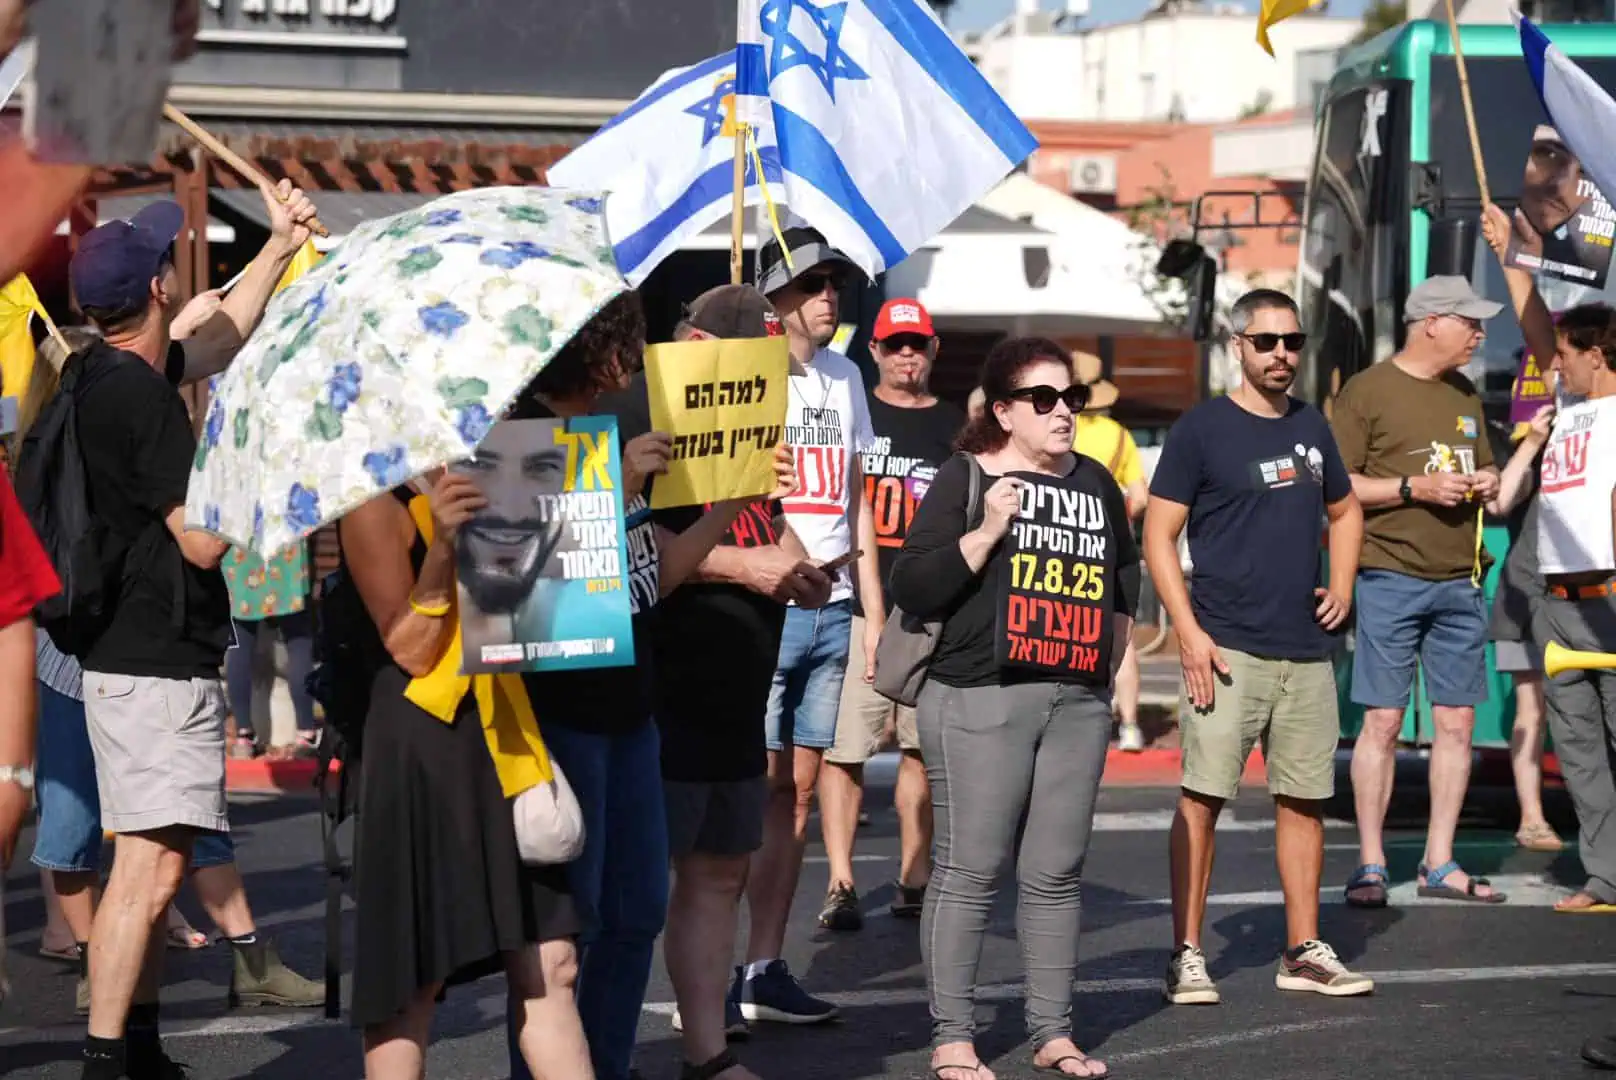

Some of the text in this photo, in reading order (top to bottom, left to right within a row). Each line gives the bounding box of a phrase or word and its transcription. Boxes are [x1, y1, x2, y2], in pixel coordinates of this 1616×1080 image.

[685, 374, 768, 409] למה הם
[673, 424, 781, 460] עדיין בעזה
[817, 427, 844, 446] אותם
[553, 426, 615, 492] אל
[537, 491, 616, 522] תשאירו
[1019, 481, 1105, 531] עוצרים
[571, 519, 618, 549] אותי
[1012, 522, 1106, 560] את הטירוף
[556, 549, 621, 580] מאחור
[1009, 552, 1105, 601] 17.8.25
[1007, 593, 1103, 644] עוצרים
[1007, 632, 1100, 672] את ישראל
